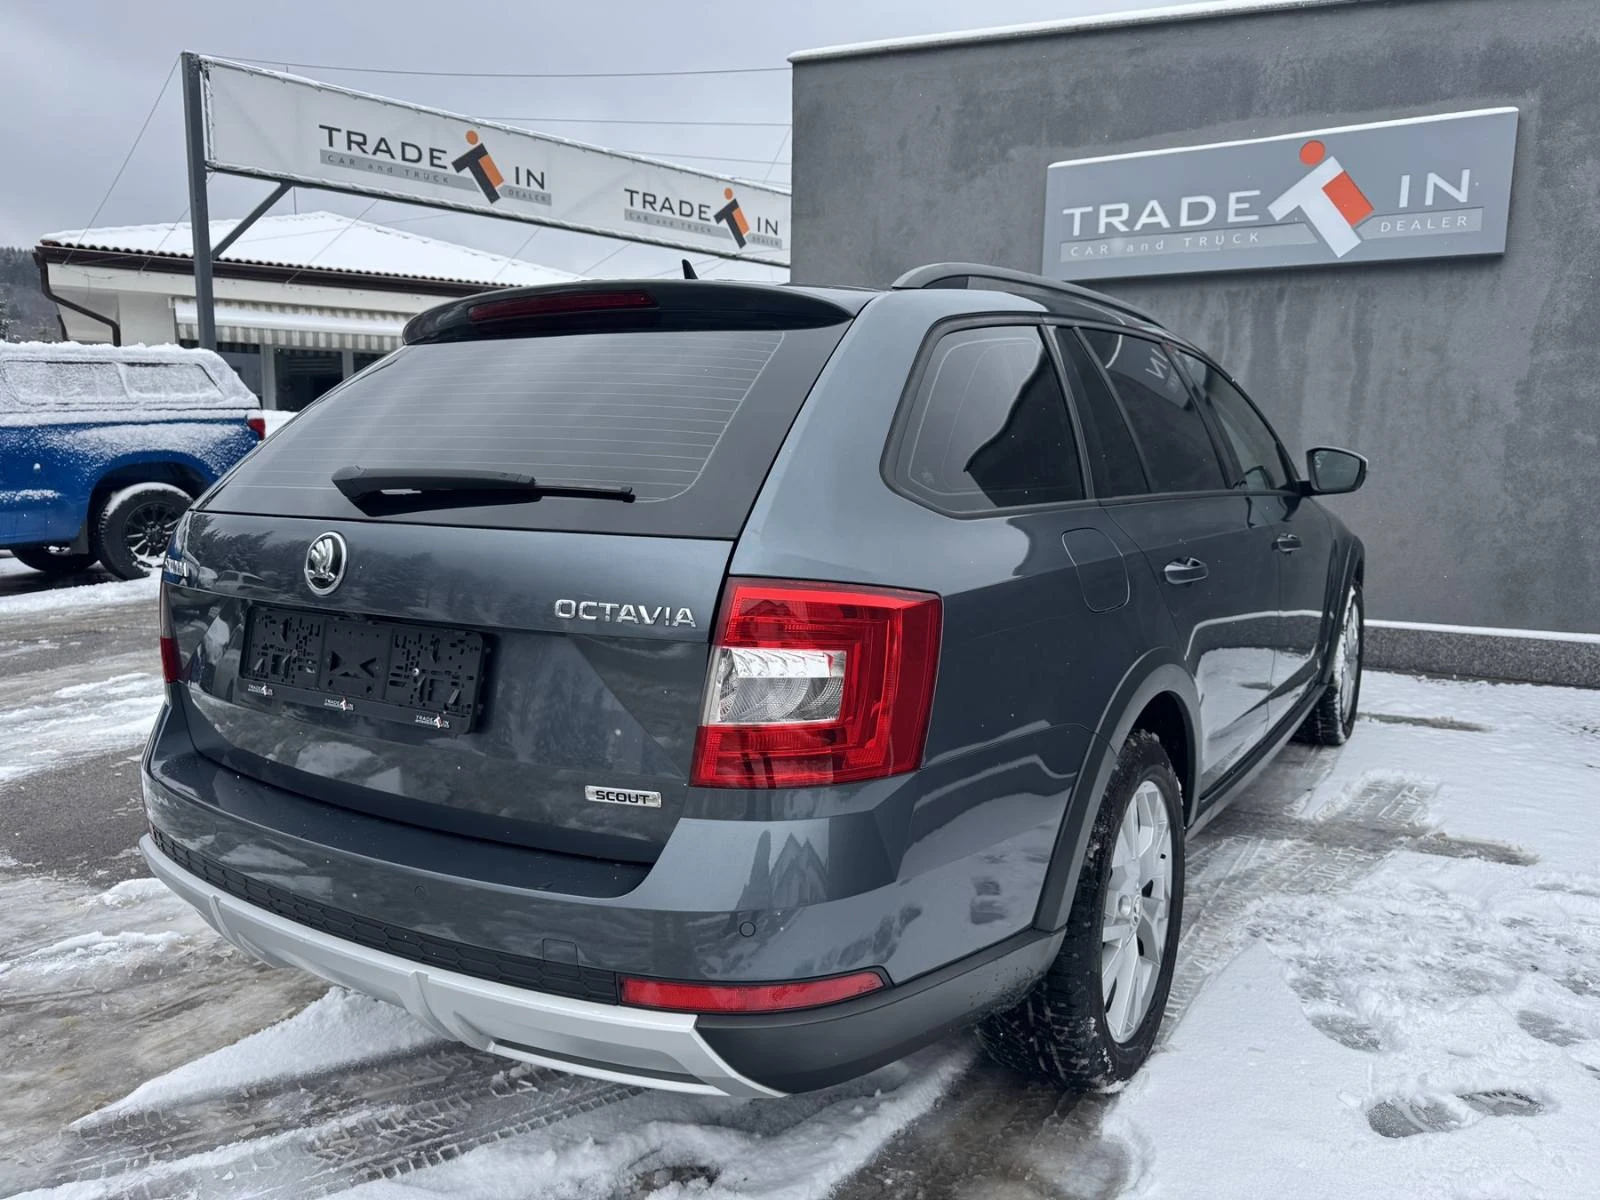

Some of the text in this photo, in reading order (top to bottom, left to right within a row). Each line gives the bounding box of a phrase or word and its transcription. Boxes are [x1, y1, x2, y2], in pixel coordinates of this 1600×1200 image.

[318, 124, 448, 170] TRADE
[515, 166, 545, 190] IN
[327, 154, 547, 202] CAR and TRUCK DEALER
[624, 188, 712, 222] TRADE
[757, 215, 778, 236] IN
[1062, 190, 1261, 237] TRADE
[1398, 168, 1471, 208] IN
[1069, 214, 1468, 257] CAR and TRUCK DEALER
[554, 599, 697, 628] OCTAVIA
[595, 789, 650, 805] SCOUT
